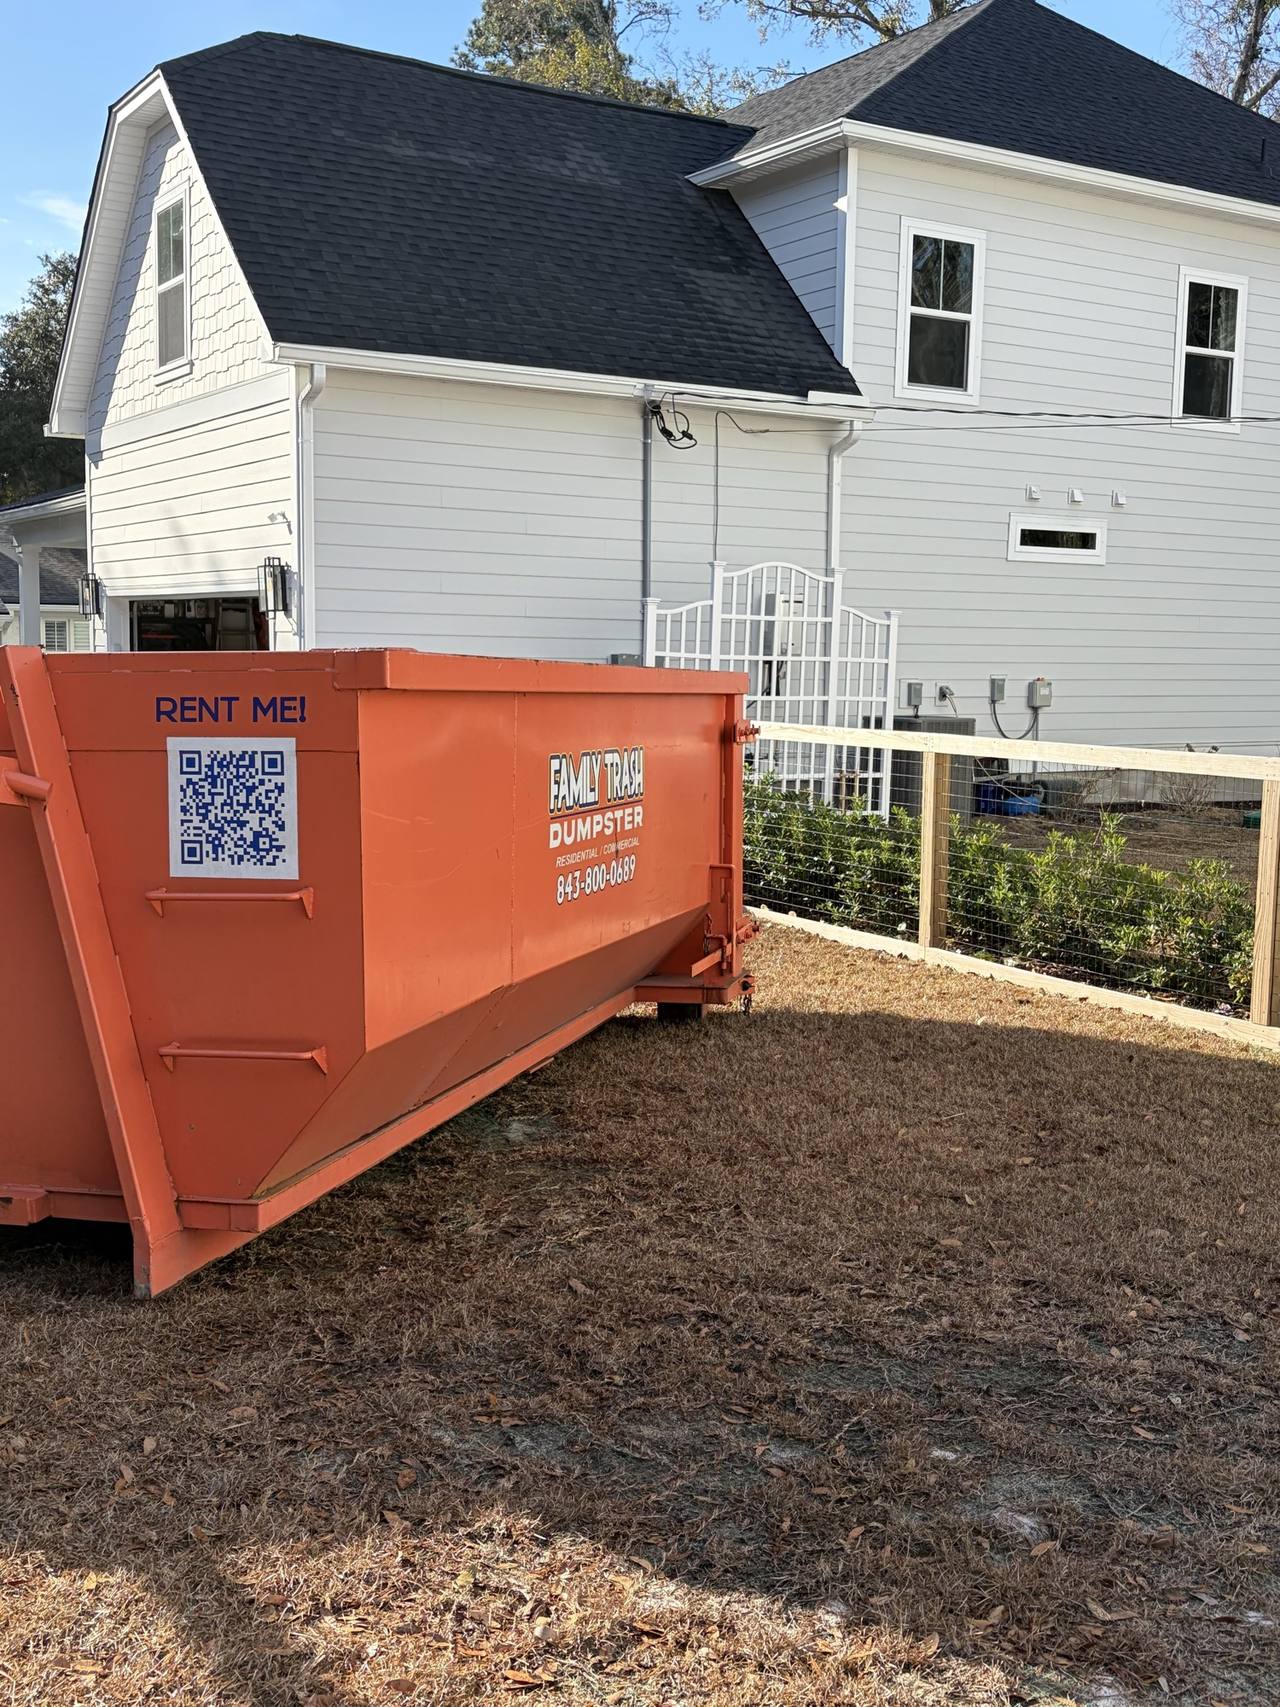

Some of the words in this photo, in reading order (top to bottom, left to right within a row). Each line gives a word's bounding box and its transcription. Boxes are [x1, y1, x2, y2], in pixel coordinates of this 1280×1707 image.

[155, 696, 240, 723] RENT
[252, 696, 306, 723] ME!
[549, 751, 601, 814] FAMILY
[603, 747, 644, 802] TRASH
[549, 805, 643, 848] DUMPSTER
[556, 847, 598, 867] RESIDENTIAL
[603, 837, 640, 855] COMMERCIAL
[556, 854, 636, 905] 843-800-0689
